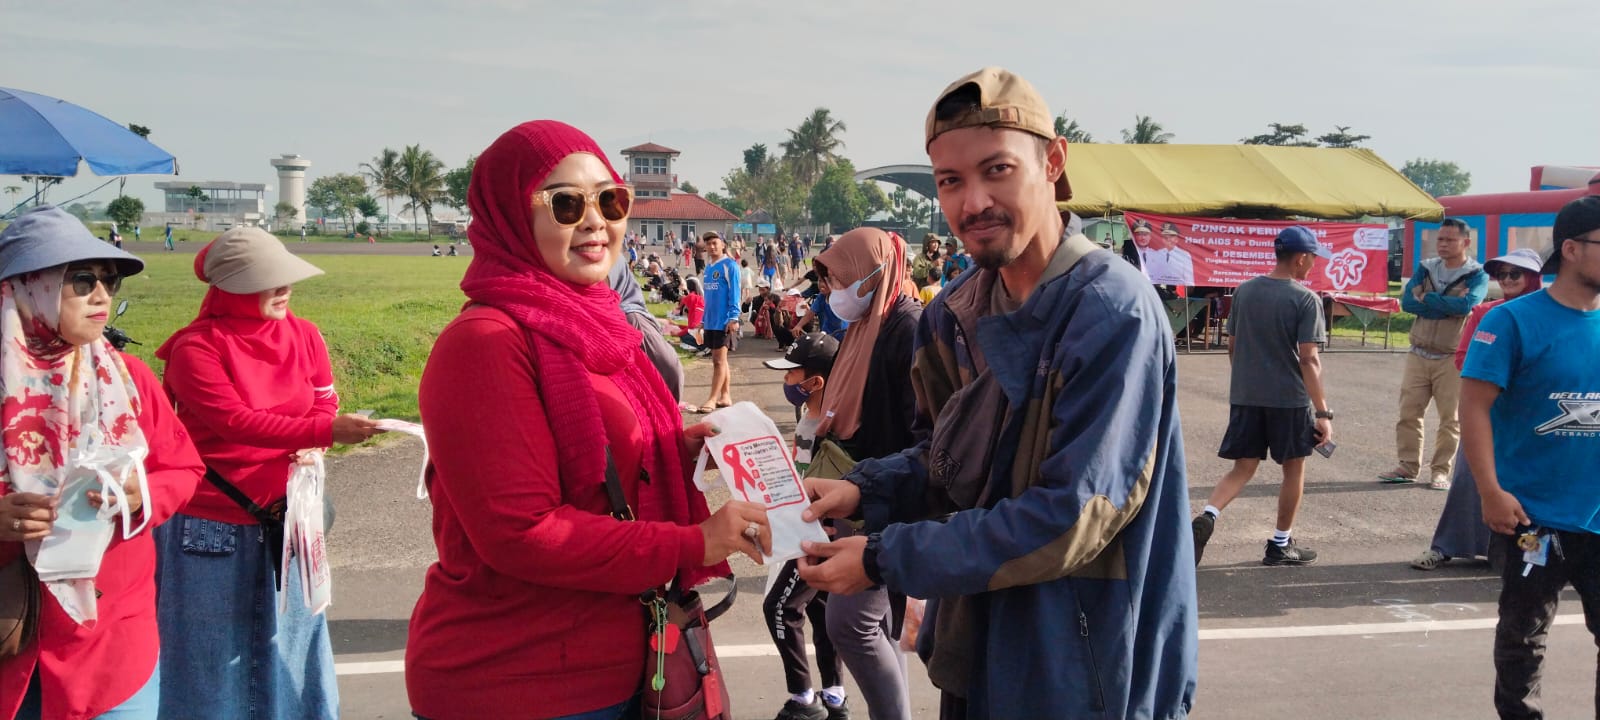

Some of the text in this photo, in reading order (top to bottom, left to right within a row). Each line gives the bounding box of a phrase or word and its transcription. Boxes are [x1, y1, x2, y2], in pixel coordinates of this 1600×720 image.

[1191, 223, 1327, 238] PUNCAK PERIN
[1185, 236, 1205, 245] Hari
[1208, 238, 1231, 246] AIDS
[1234, 239, 1246, 247] Se
